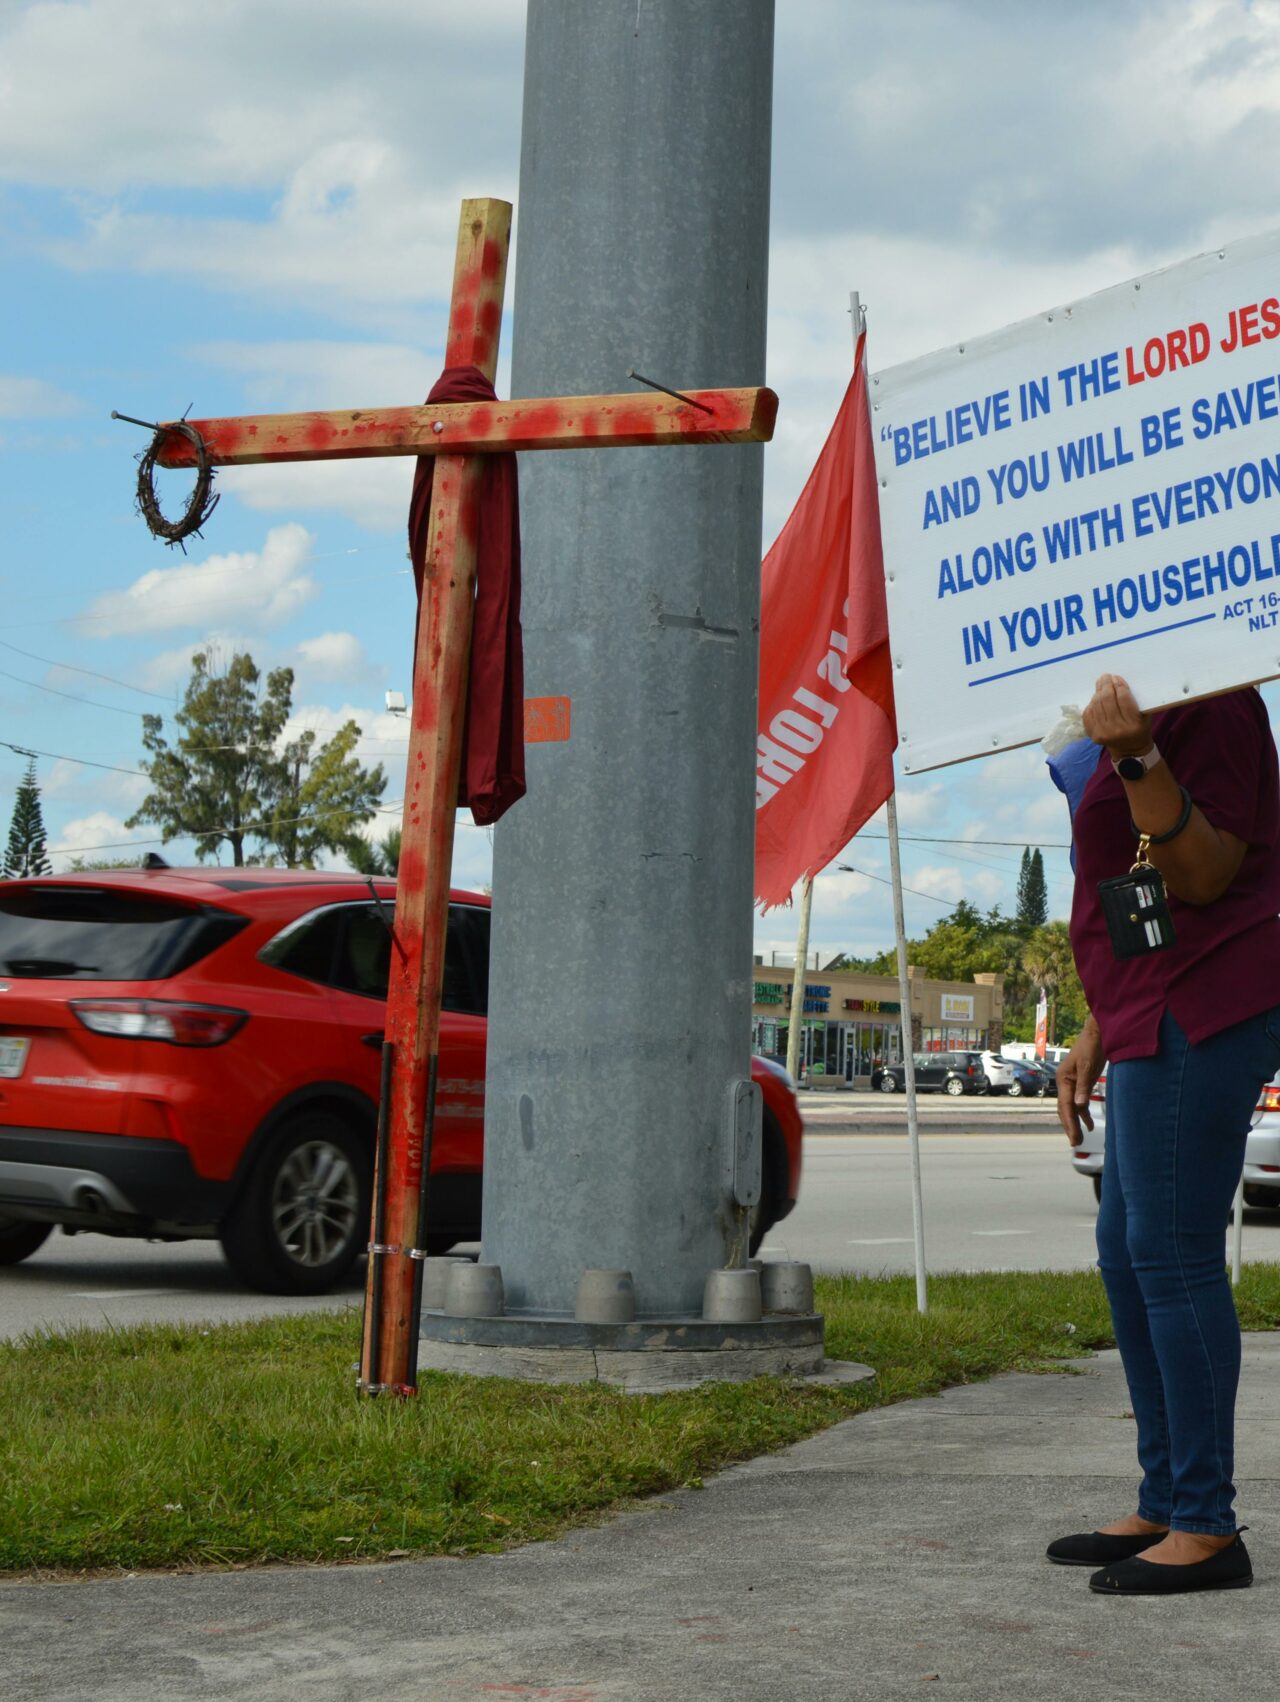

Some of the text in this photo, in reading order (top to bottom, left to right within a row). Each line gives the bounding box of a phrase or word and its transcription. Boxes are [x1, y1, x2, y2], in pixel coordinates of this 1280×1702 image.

[1020, 376, 1051, 421] IN
[1058, 352, 1121, 406] THE
[1127, 324, 1210, 384] LORD
[924, 476, 980, 529] AND
[988, 451, 1050, 505] YOU
[1058, 426, 1132, 483] WILL
[1141, 407, 1184, 456] BE
[938, 532, 1037, 598] ALONG
[1043, 504, 1125, 564] WITH
[962, 620, 994, 665] IN
[1000, 594, 1085, 653] YOUR
[1224, 598, 1253, 619] ACT
[1249, 611, 1278, 630] NLT
